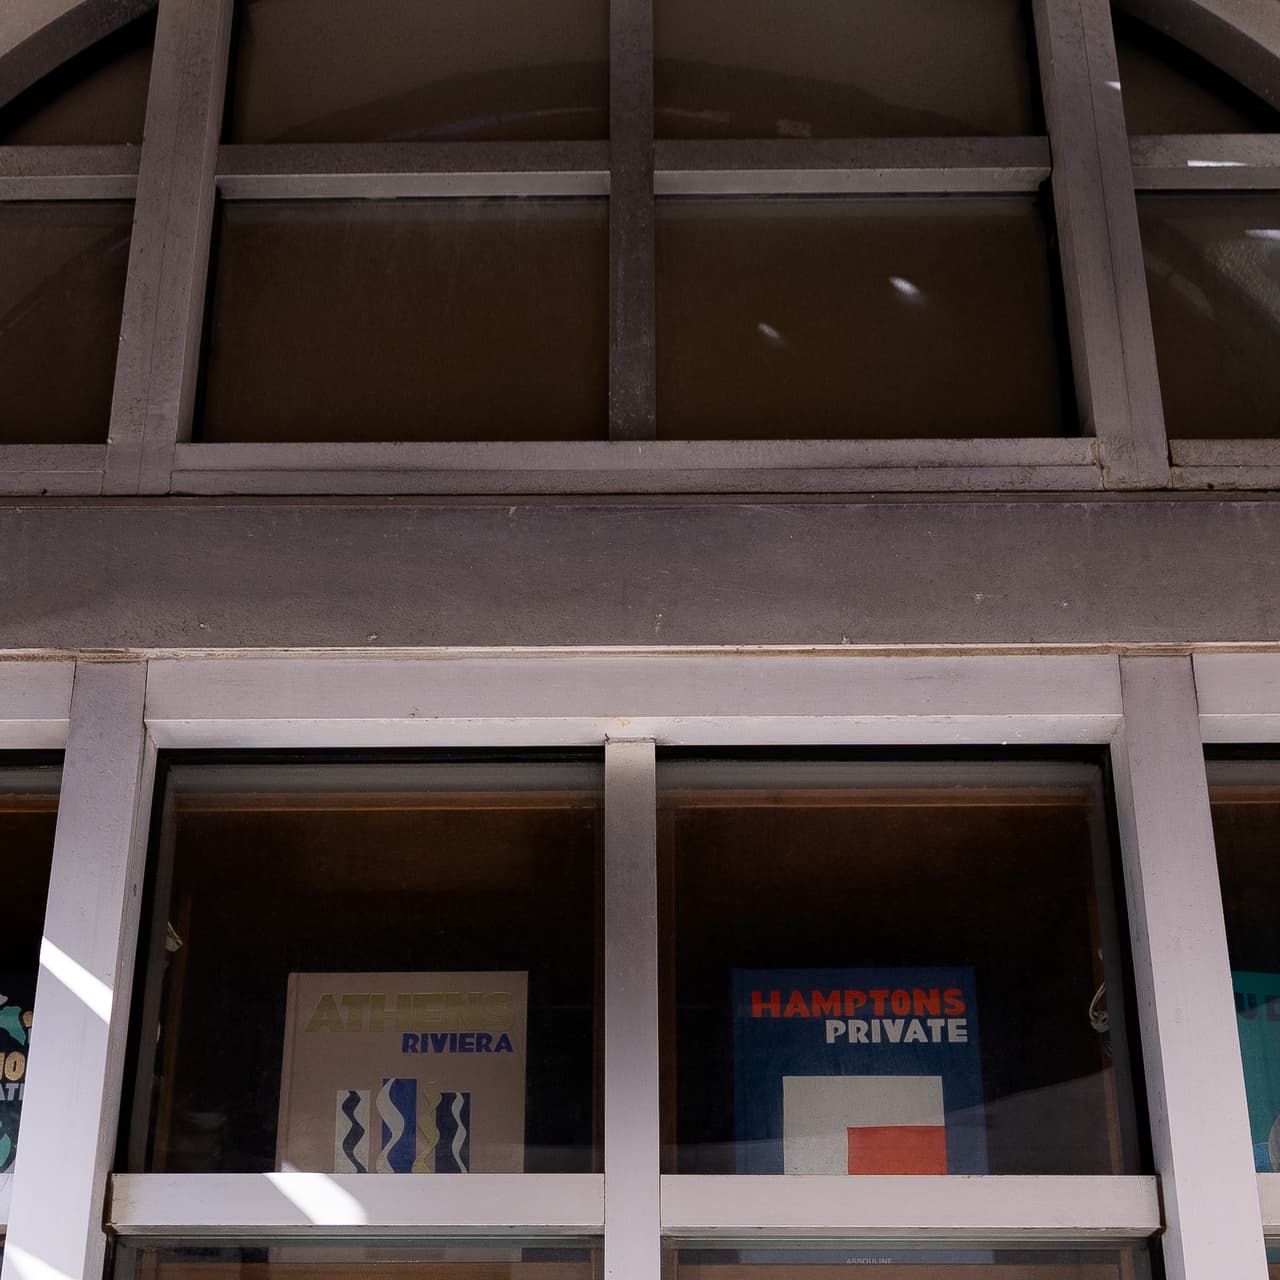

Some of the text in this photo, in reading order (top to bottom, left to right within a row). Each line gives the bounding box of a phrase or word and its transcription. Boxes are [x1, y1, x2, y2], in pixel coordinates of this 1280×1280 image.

[304, 991, 515, 1033] ATHENS
[751, 988, 966, 1018] HAMPTONS
[401, 1032, 513, 1054] RIVIERA
[824, 1018, 968, 1044] PRIVATE
